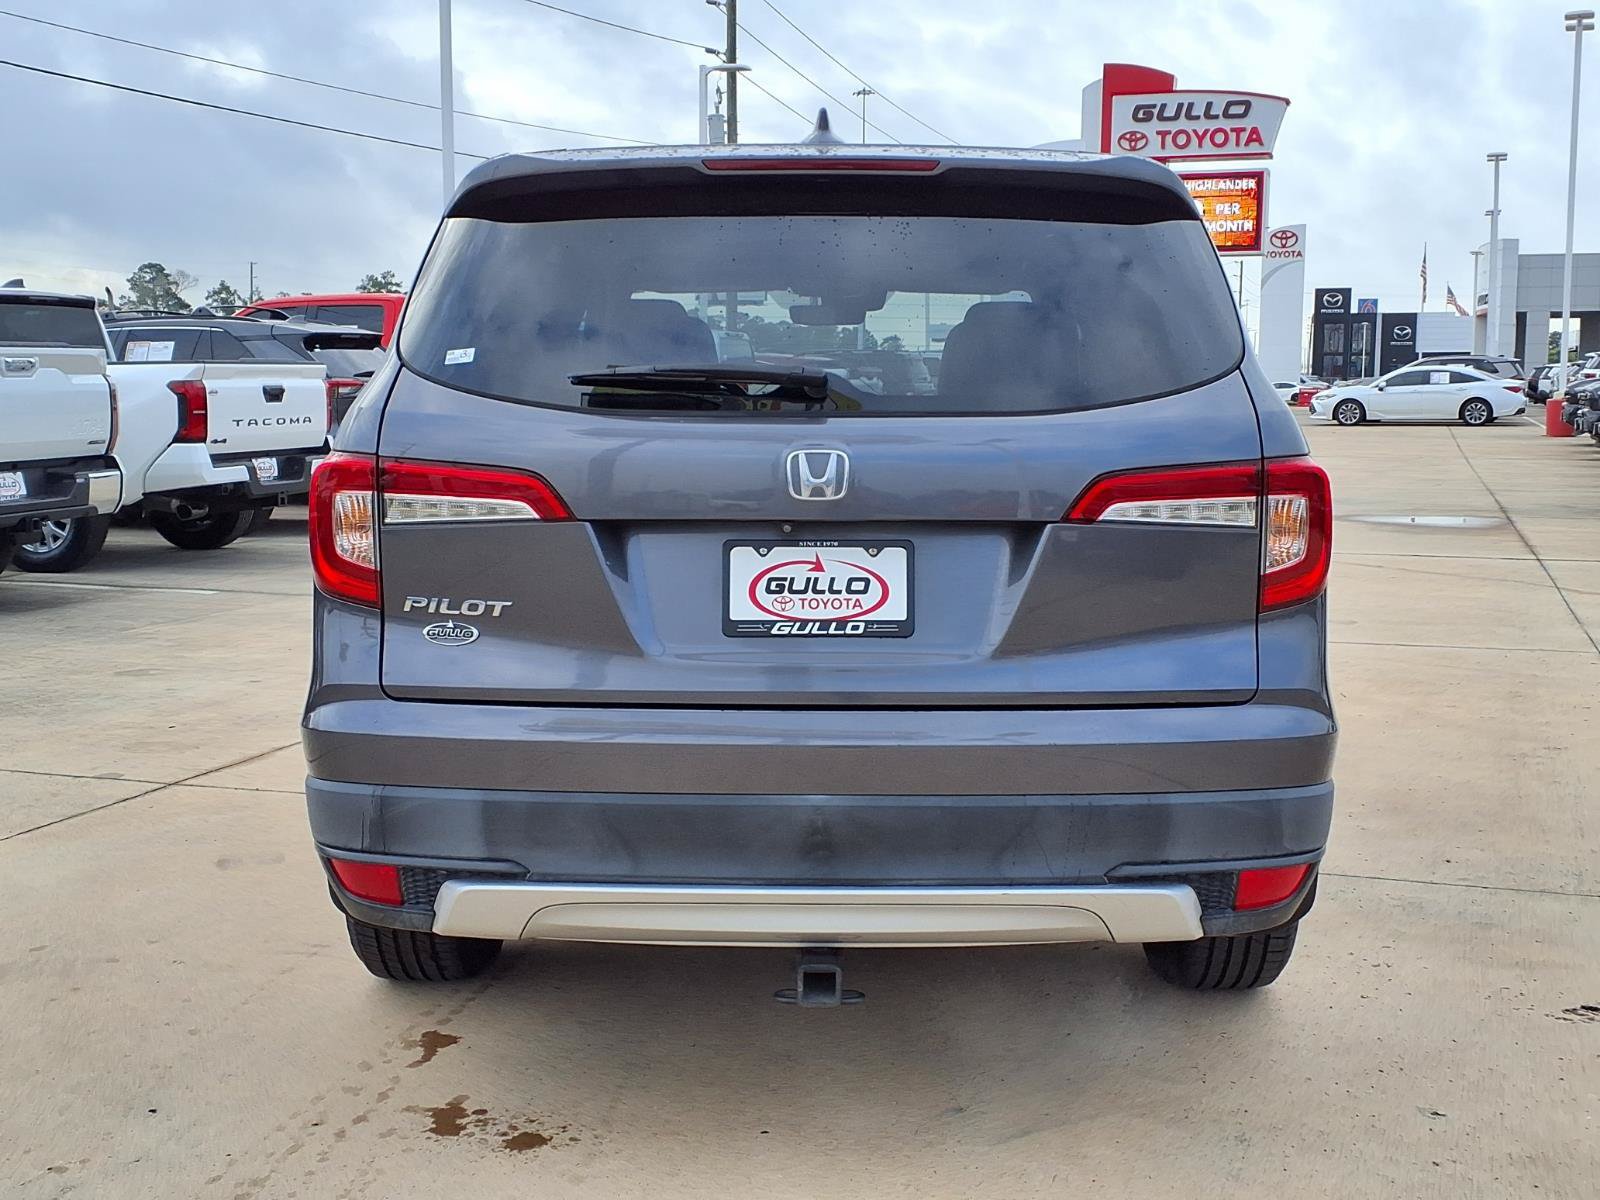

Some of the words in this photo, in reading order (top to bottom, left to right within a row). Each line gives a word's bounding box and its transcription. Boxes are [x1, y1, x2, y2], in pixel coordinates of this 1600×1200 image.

[1131, 99, 1252, 123] GULLO
[1156, 126, 1264, 150] TOYOTA
[1215, 203, 1241, 215] PER
[1203, 219, 1253, 232] MONTH
[232, 416, 312, 427] TACOMA
[764, 576, 871, 595] GULLO
[403, 596, 513, 617] PILOT
[798, 598, 863, 610] TOYOTA
[426, 628, 474, 639] GULLO
[770, 621, 866, 635] GULLO
